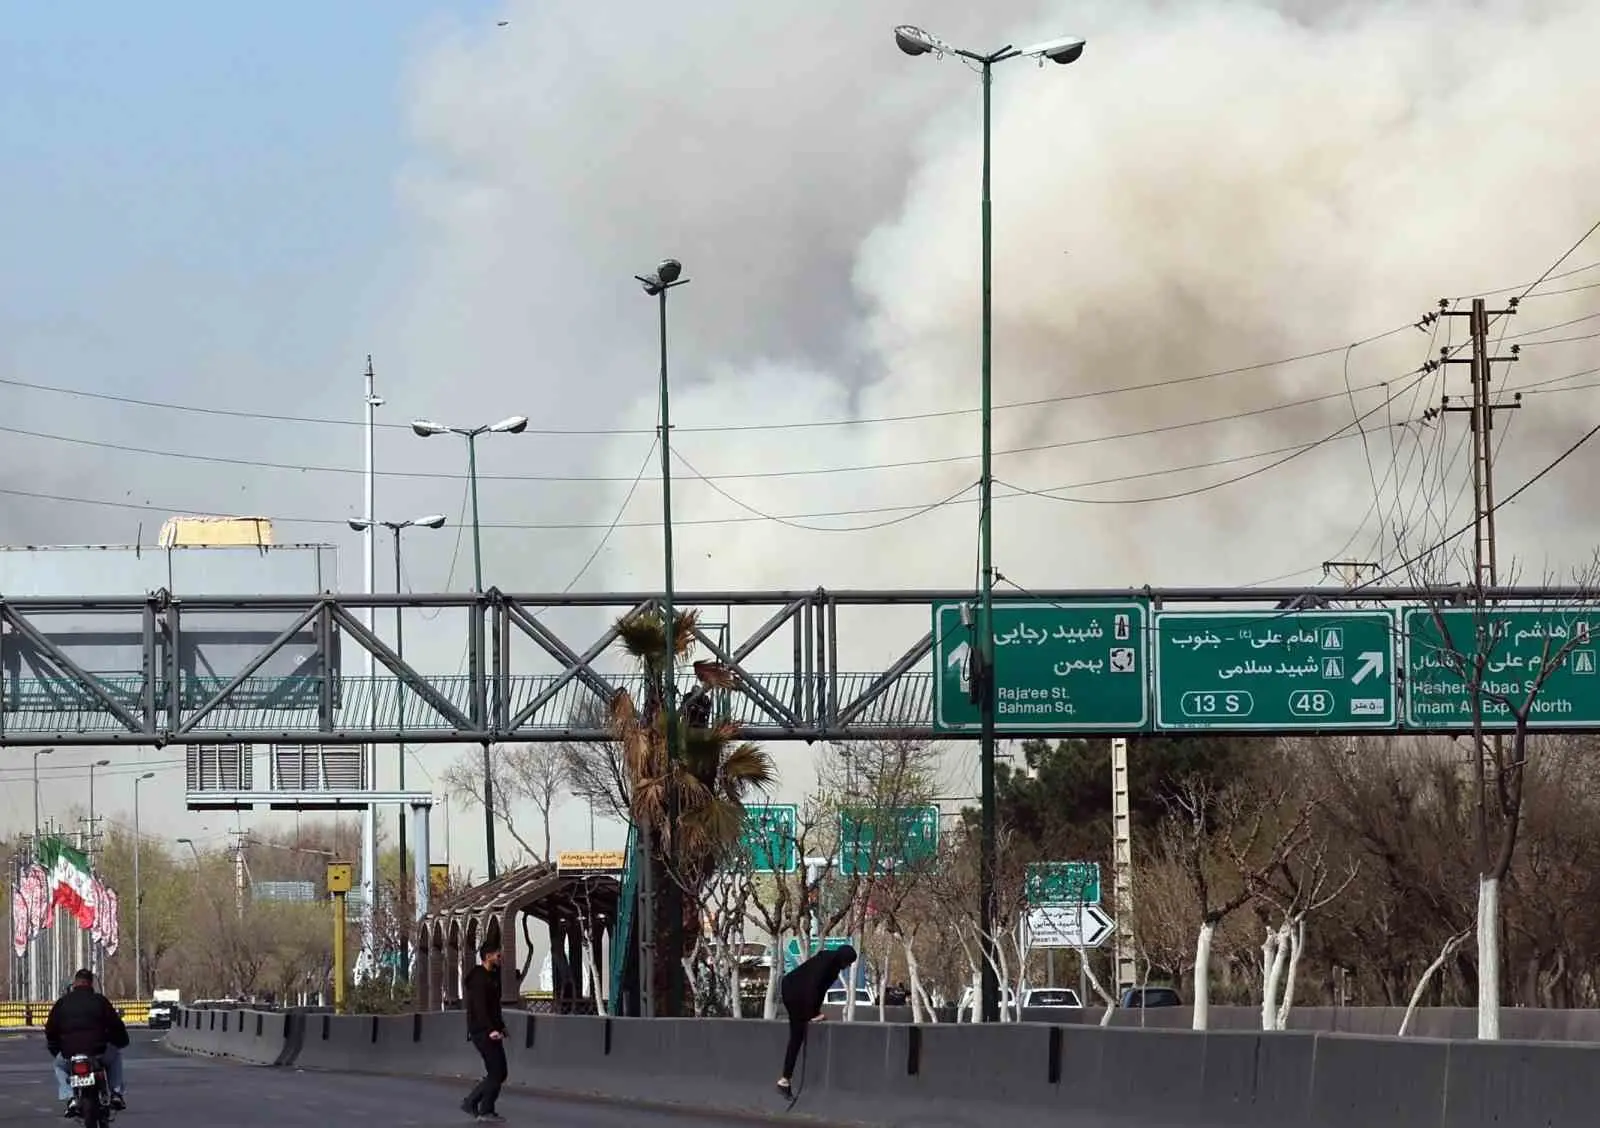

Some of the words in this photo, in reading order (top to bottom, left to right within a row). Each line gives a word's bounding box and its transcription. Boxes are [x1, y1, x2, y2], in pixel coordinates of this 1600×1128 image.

[993, 622, 1048, 645] رجایی
[1052, 619, 1103, 644] شهید
[1171, 630, 1221, 651] جنوب
[1250, 629, 1282, 649] علی
[1287, 629, 1318, 652] امام
[1053, 657, 1104, 676] بهمن
[1218, 659, 1273, 680] سلامی
[1275, 656, 1319, 677] شهید
[1487, 652, 1523, 673] علی
[998, 687, 1048, 701] Raja'ee
[1051, 687, 1070, 699] St.
[1194, 694, 1216, 712] 13
[1225, 694, 1240, 712] S
[1296, 694, 1325, 711] 48
[998, 701, 1052, 713] Bahman
[1054, 701, 1076, 715] Sq.
[1530, 699, 1572, 713] North
